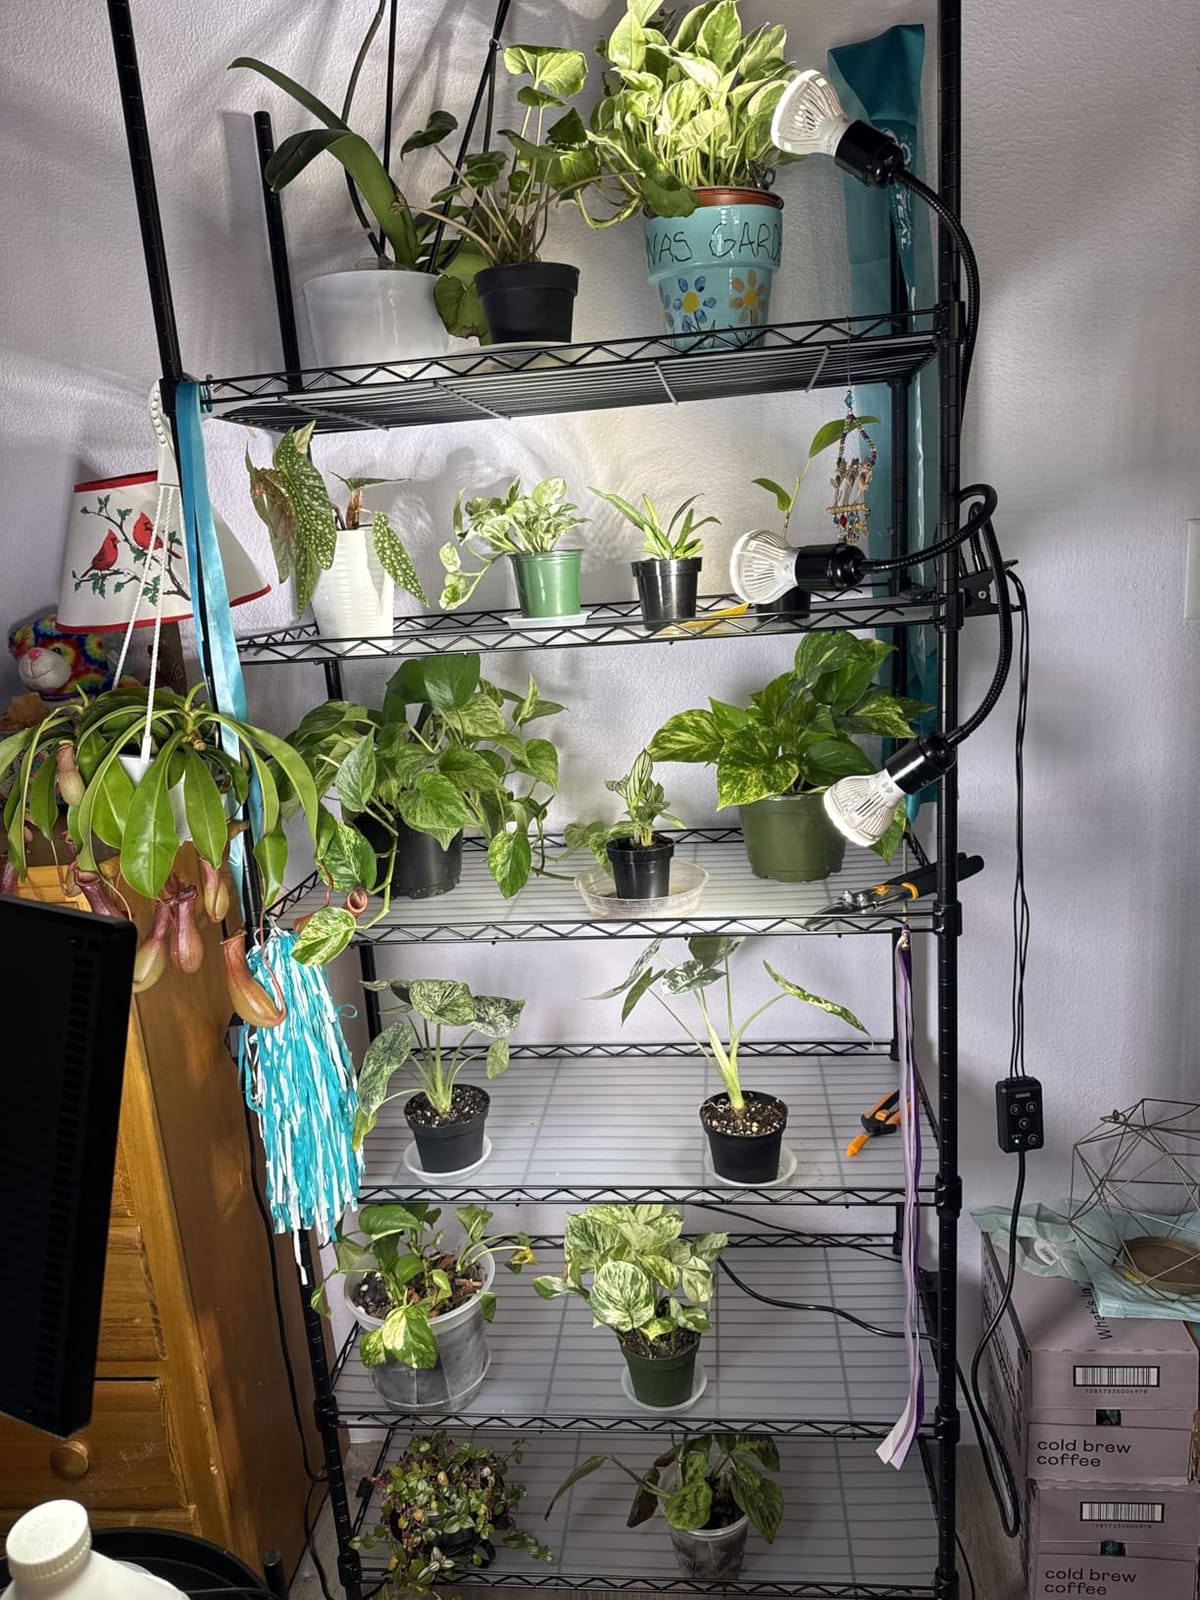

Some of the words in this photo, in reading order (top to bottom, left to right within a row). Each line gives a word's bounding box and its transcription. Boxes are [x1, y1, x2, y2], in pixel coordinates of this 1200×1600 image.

[1037, 1438, 1077, 1451] cold
[1083, 1439, 1131, 1454] brew
[1036, 1453, 1101, 1468] coffee
[1045, 1567, 1084, 1580] cold
[1090, 1568, 1137, 1583] brew
[1044, 1581, 1107, 1596] coffee
